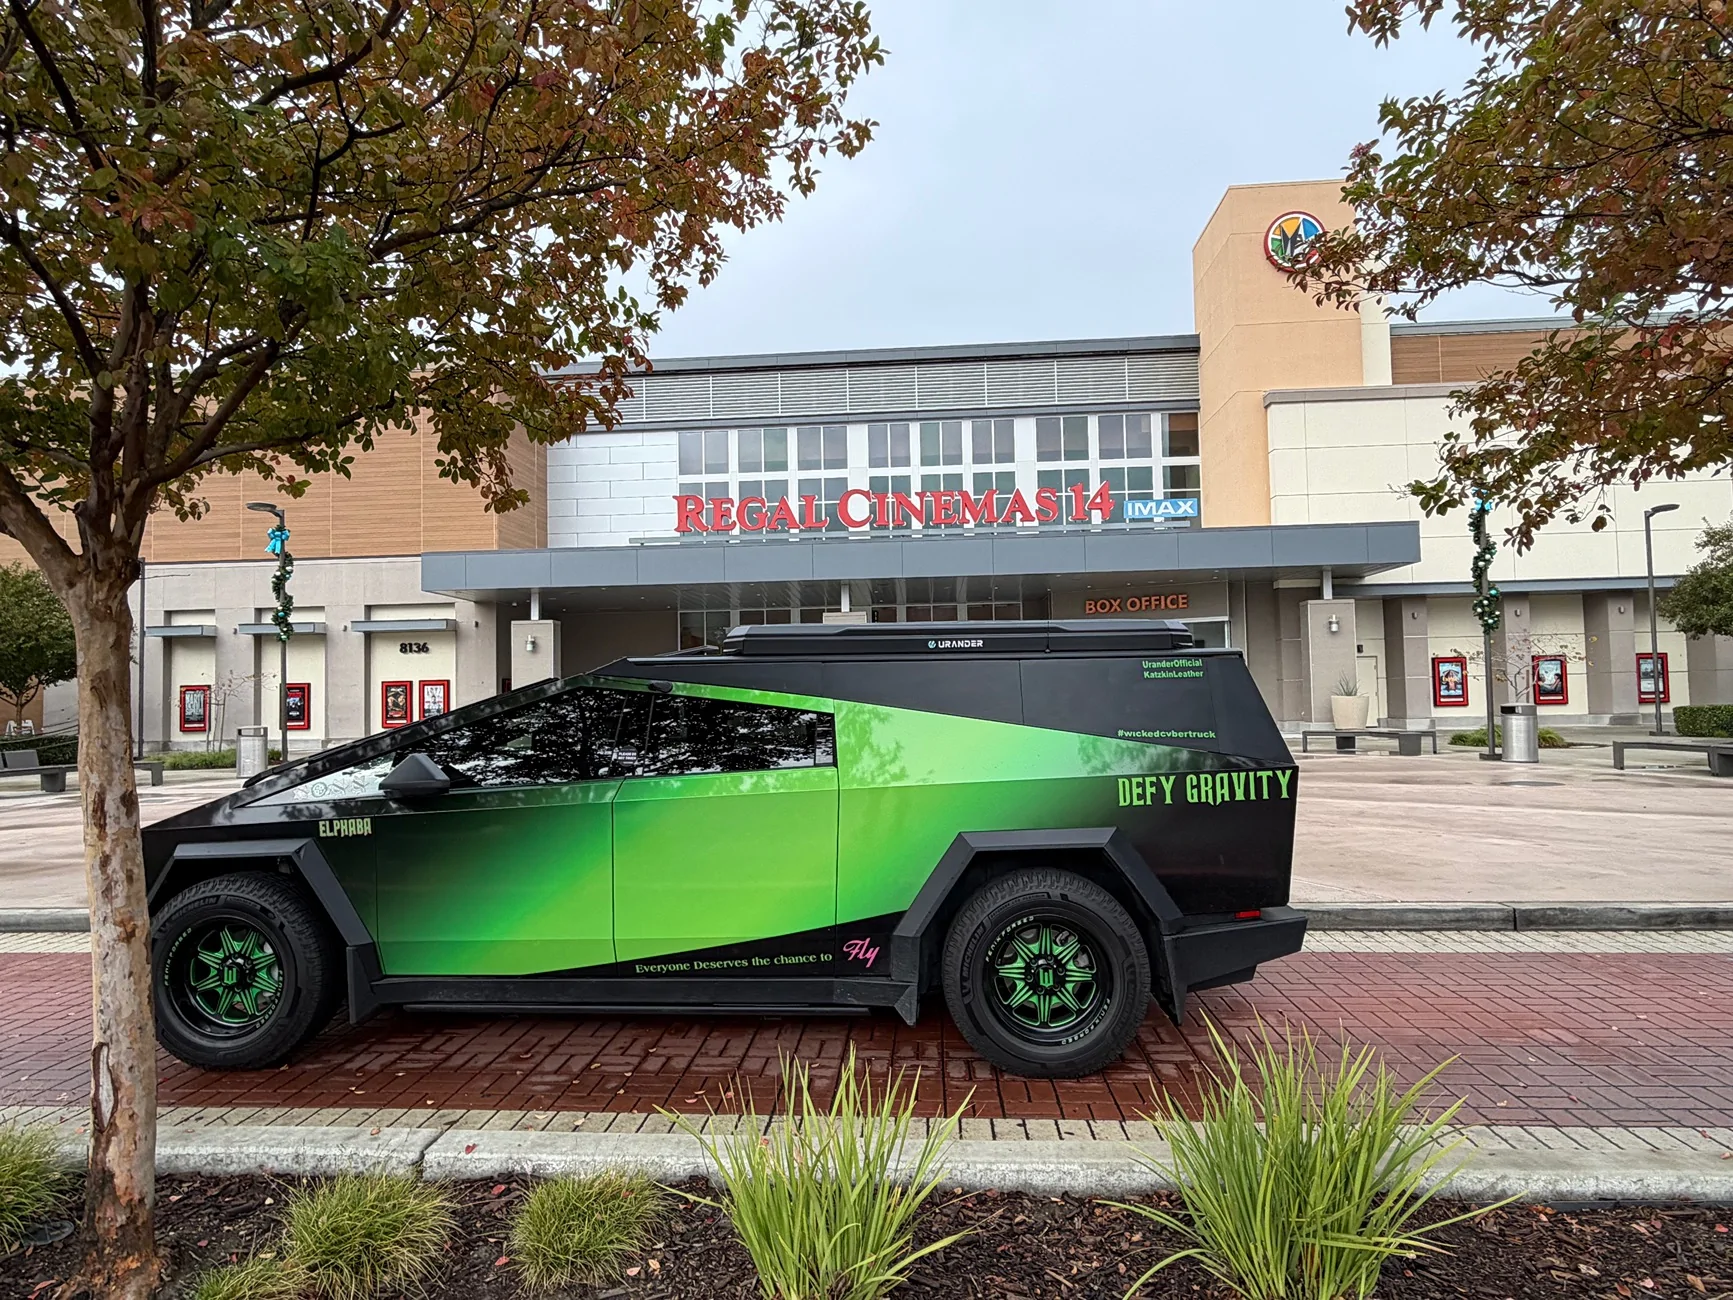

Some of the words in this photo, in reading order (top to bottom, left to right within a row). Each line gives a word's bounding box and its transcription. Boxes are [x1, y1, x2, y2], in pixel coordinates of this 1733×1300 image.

[673, 494, 829, 532] REGAL
[837, 487, 1059, 529] CINEMAS
[1068, 480, 1116, 521] 14
[1127, 500, 1195, 516] IMAX
[1085, 599, 1122, 614] BOX
[1126, 594, 1189, 612] OFFICE
[399, 642, 430, 654] 8136
[938, 639, 984, 649] URANDER
[1142, 659, 1203, 669] UranderOfficial
[1143, 670, 1204, 679] KatzkinLeather
[1117, 775, 1177, 807] DEFY
[1186, 769, 1293, 806] GRAVITY
[318, 817, 372, 838] ELPHABA
[843, 937, 881, 968] Fly
[961, 924, 986, 977] MICHELIN
[635, 960, 691, 974] Everyone
[694, 957, 749, 971] Deserves
[751, 955, 772, 966] the
[774, 953, 817, 965] chance
[820, 952, 833, 962] to
